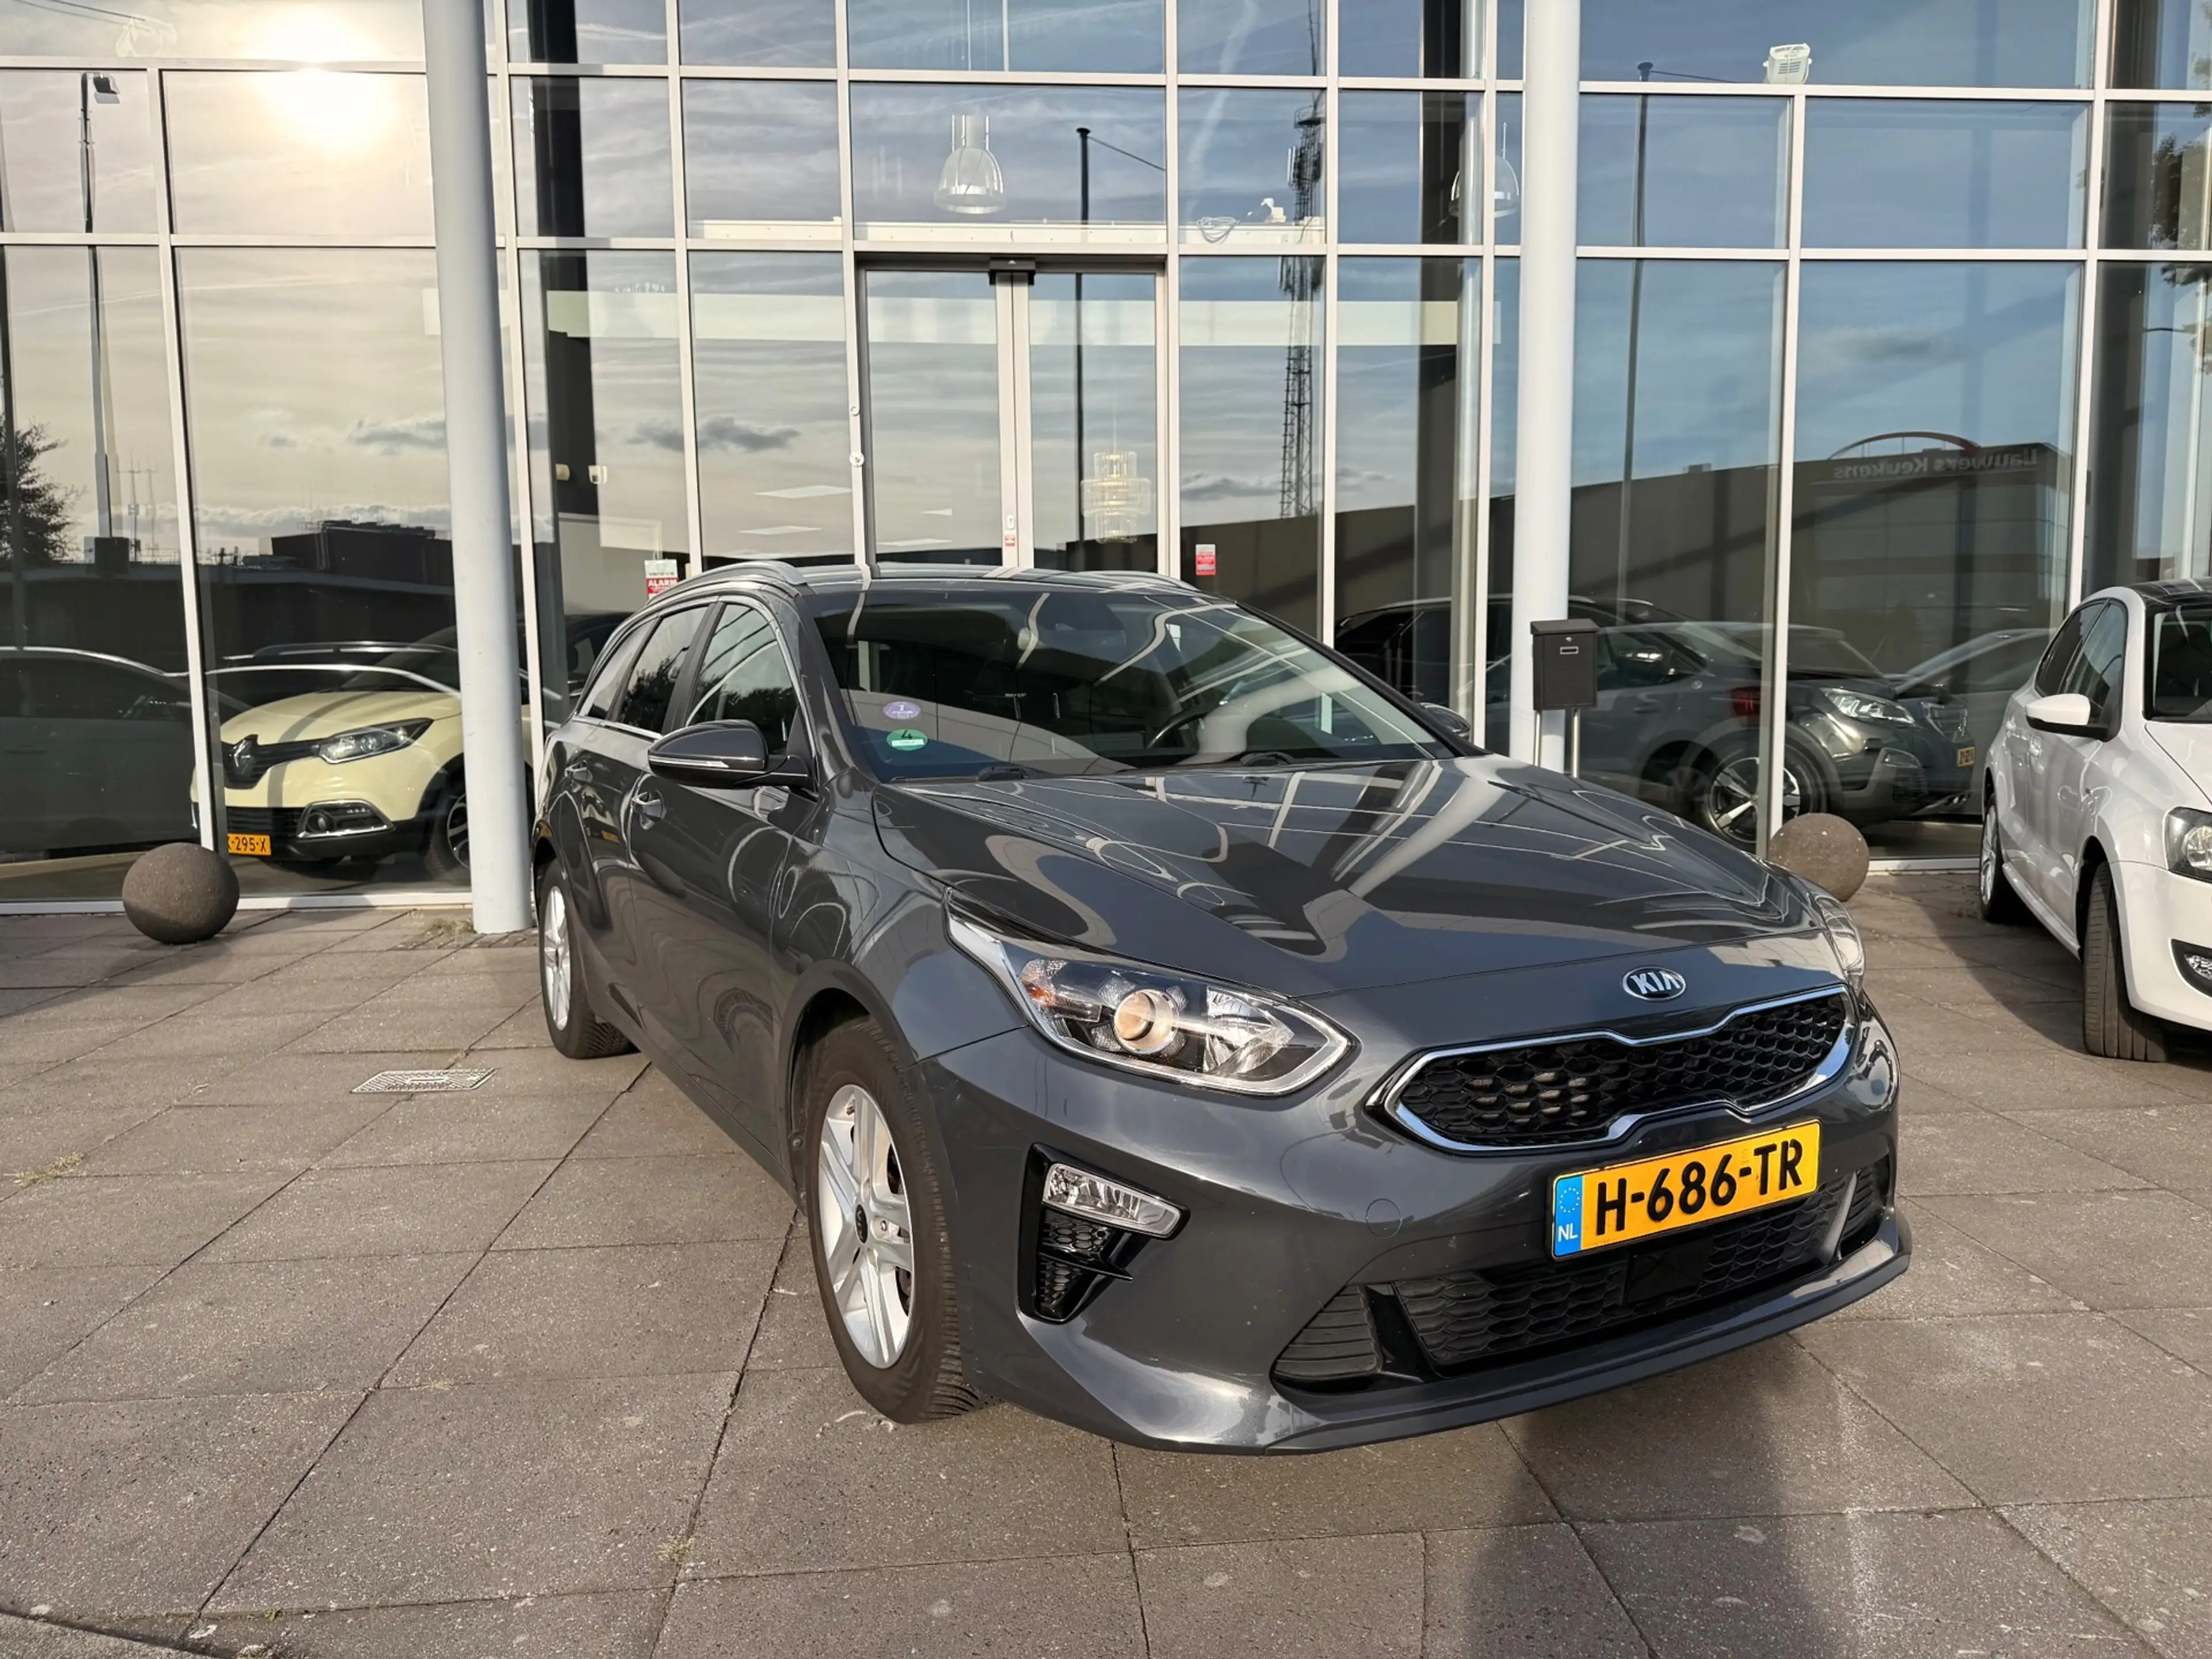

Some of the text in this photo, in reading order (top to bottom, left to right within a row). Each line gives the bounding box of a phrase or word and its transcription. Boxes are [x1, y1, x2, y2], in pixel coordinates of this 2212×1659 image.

[901, 730, 913, 740] 4
[1629, 971, 1681, 995] KIA
[1596, 1138, 1803, 1236] H-686-TR
[1557, 1224, 1578, 1243] NL
